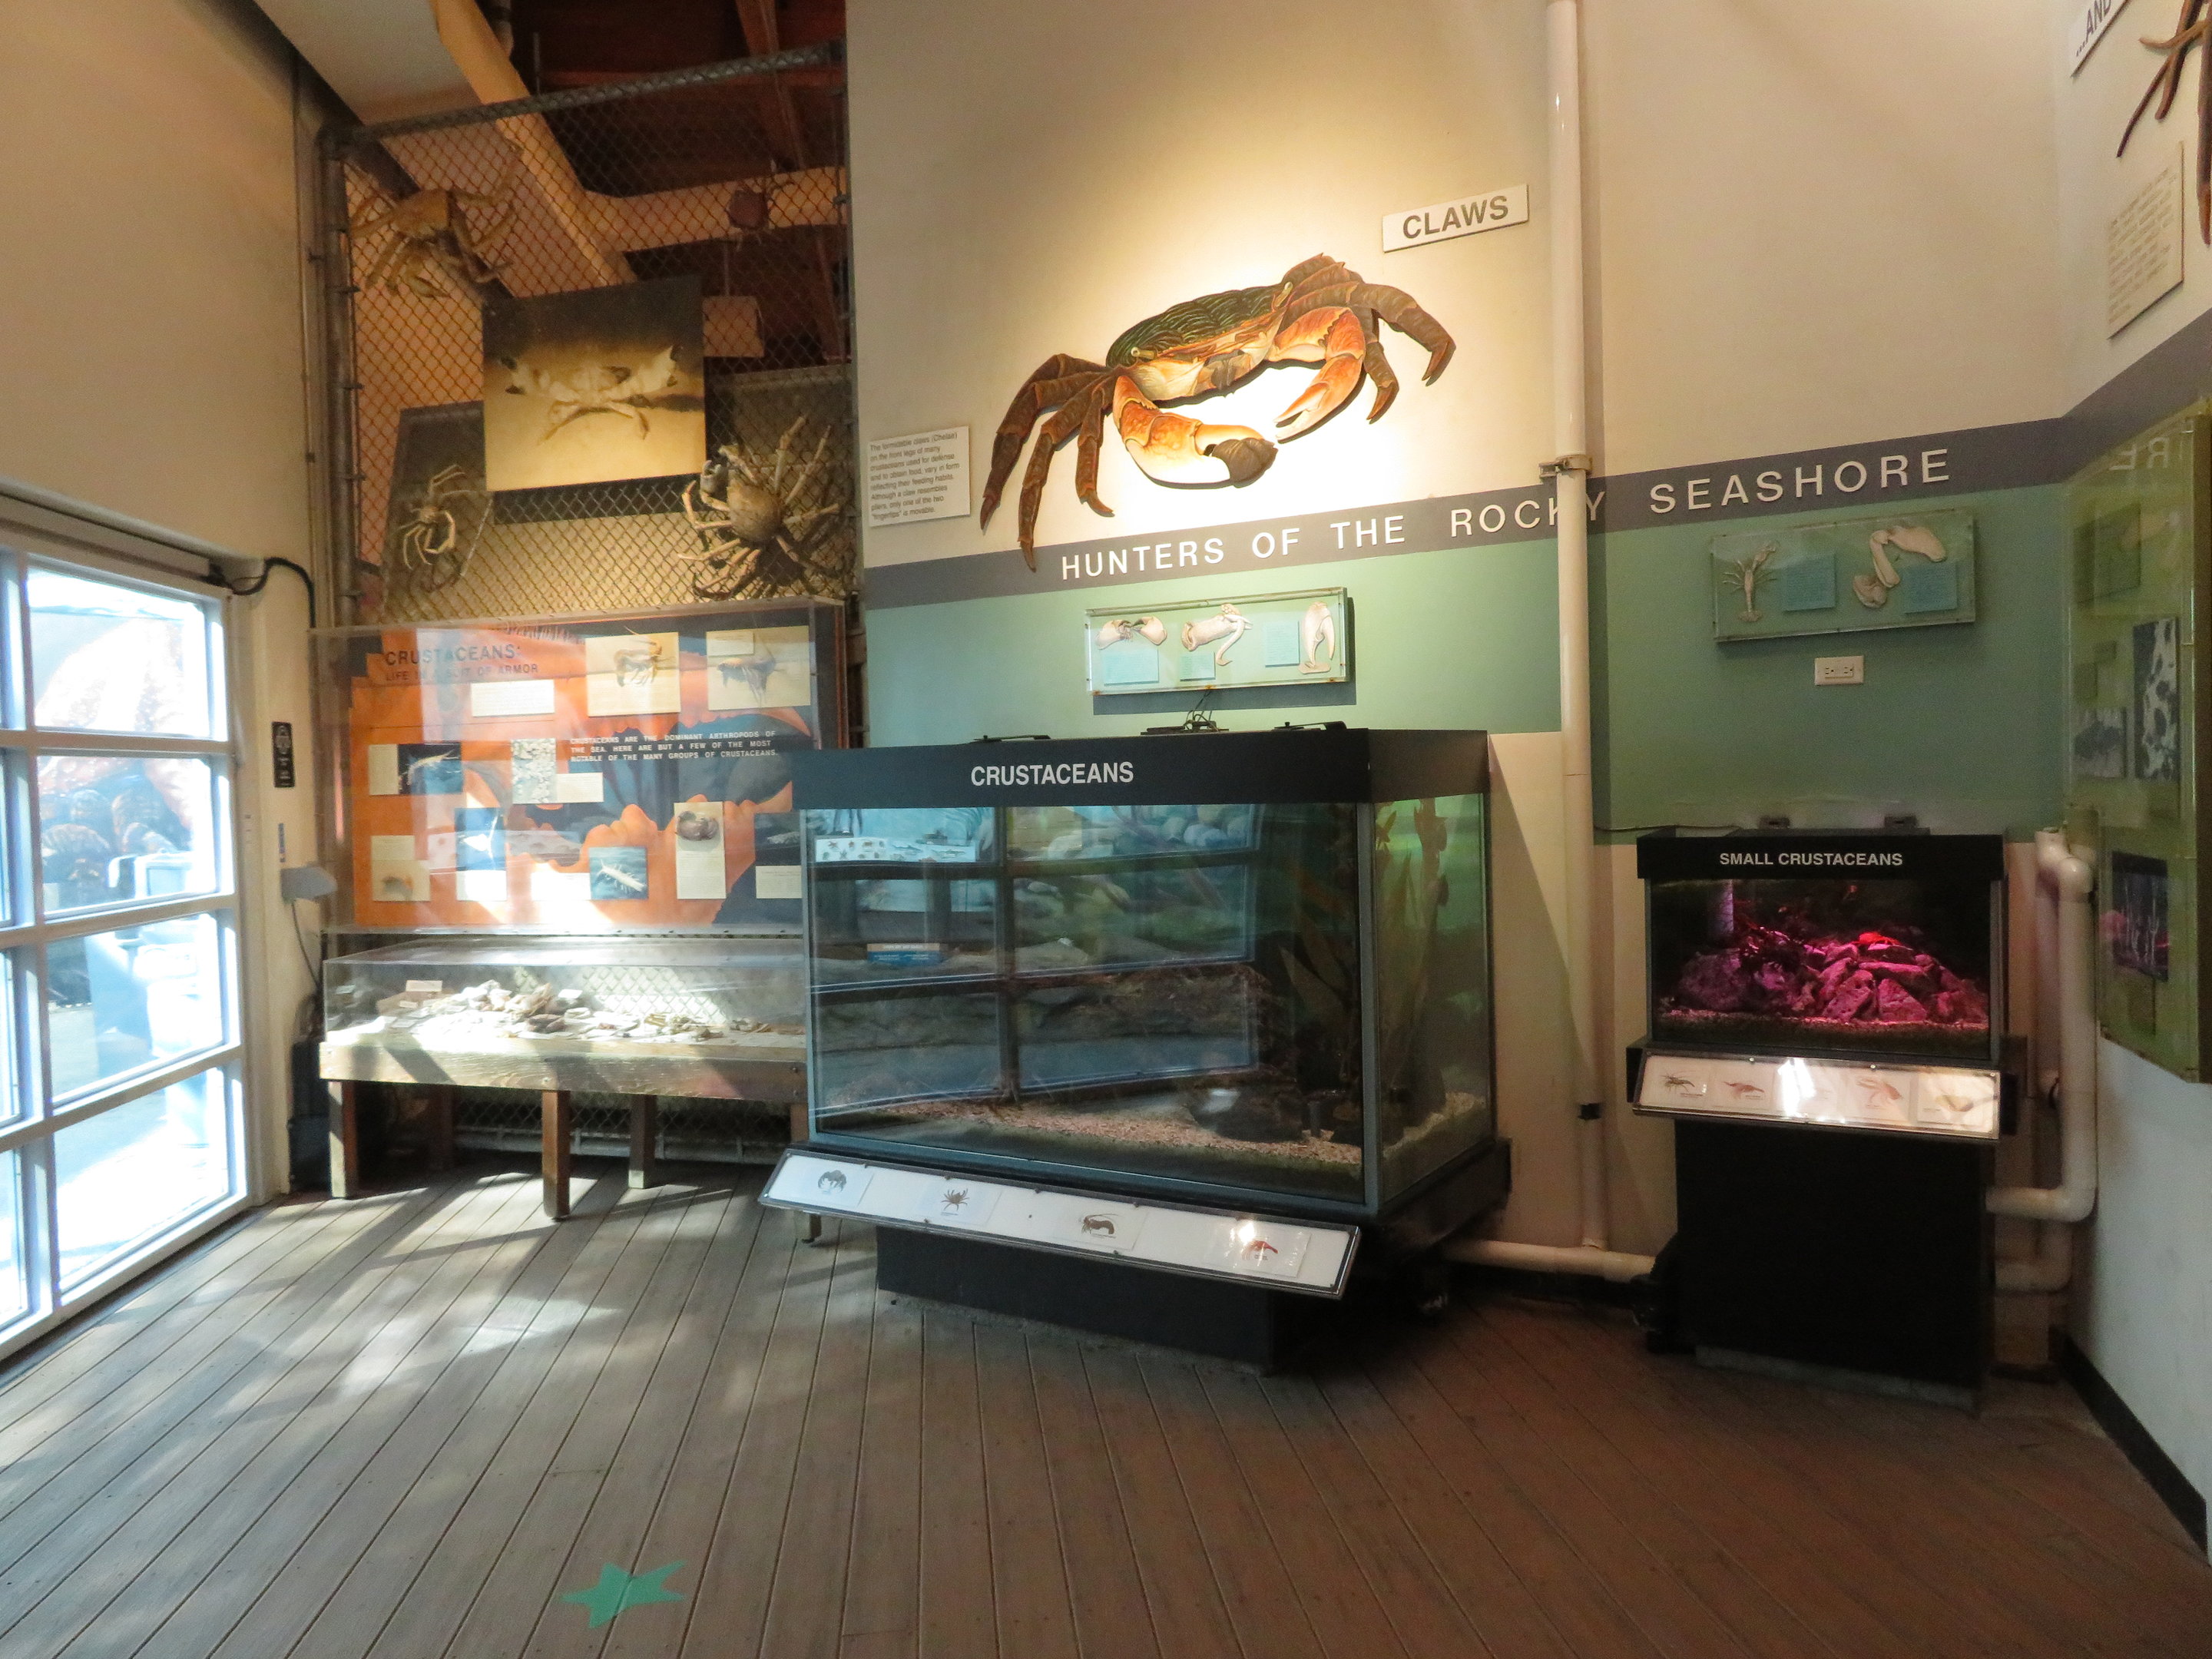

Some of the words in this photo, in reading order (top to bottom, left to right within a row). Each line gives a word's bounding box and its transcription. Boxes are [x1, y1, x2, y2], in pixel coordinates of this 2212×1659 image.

[1402, 195, 1509, 240] CLAWS
[1061, 538, 1225, 581] HUNTERS
[1251, 528, 1300, 559] OF
[1330, 515, 1406, 550] THE
[1649, 449, 1950, 515] SEASHORE
[386, 671, 409, 681] LIFE
[498, 664, 539, 675] ARMOR
[664, 733, 703, 741] DOMINANT
[709, 730, 760, 740] ARTHROPODS
[970, 761, 1134, 786] CRUSTACEANS
[1719, 853, 1774, 866] SMALL
[1778, 853, 1903, 866] CRUSTACEANS
